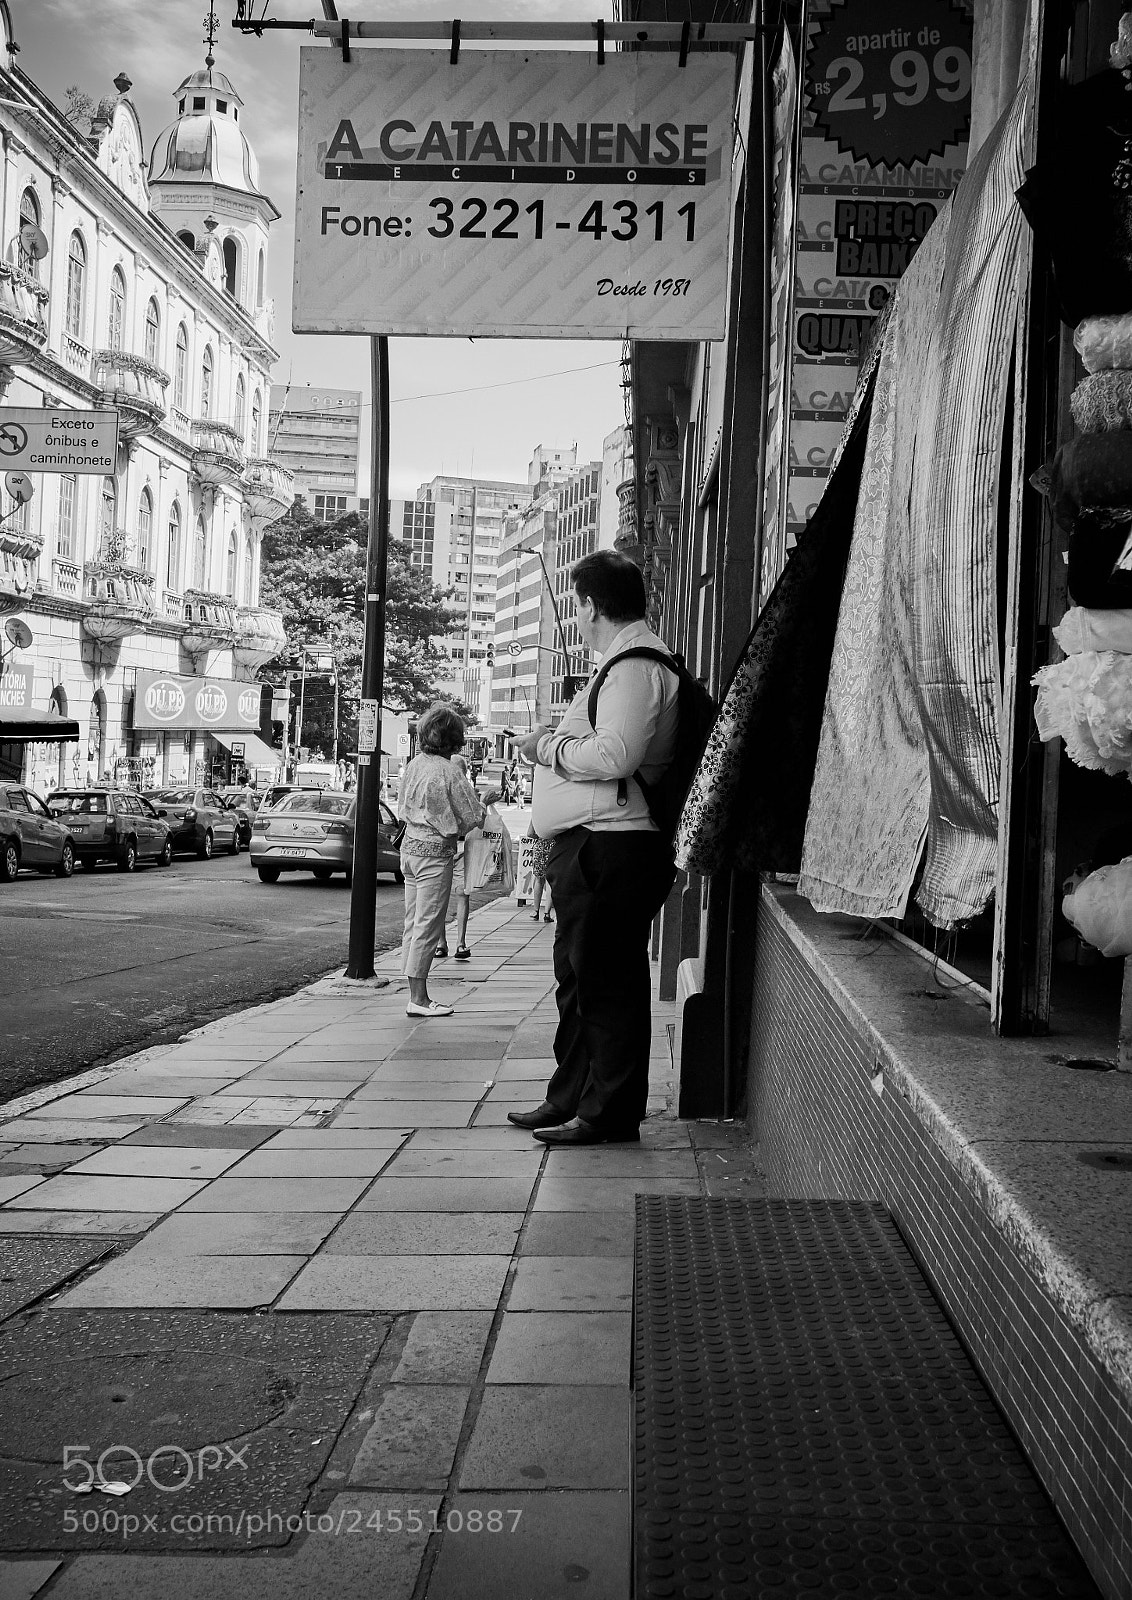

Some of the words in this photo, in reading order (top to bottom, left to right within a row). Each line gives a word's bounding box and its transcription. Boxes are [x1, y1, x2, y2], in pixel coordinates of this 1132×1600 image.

[846, 27, 911, 54] apartir
[917, 26, 941, 45] de
[814, 81, 831, 95] R$
[825, 46, 972, 121] 2,99
[325, 119, 363, 160] A
[380, 119, 708, 165] CATARINENSE
[818, 164, 967, 188] CATARINENS
[321, 206, 412, 237] Fone:
[427, 197, 696, 241] 3221-4311
[837, 202, 937, 243] PREÇO
[597, 278, 647, 296] Desde
[653, 278, 692, 296] 1981
[51, 417, 95, 430] Exceto
[45, 434, 87, 447] ônibus
[91, 439, 99, 447] e
[30, 453, 112, 466] caminhonete
